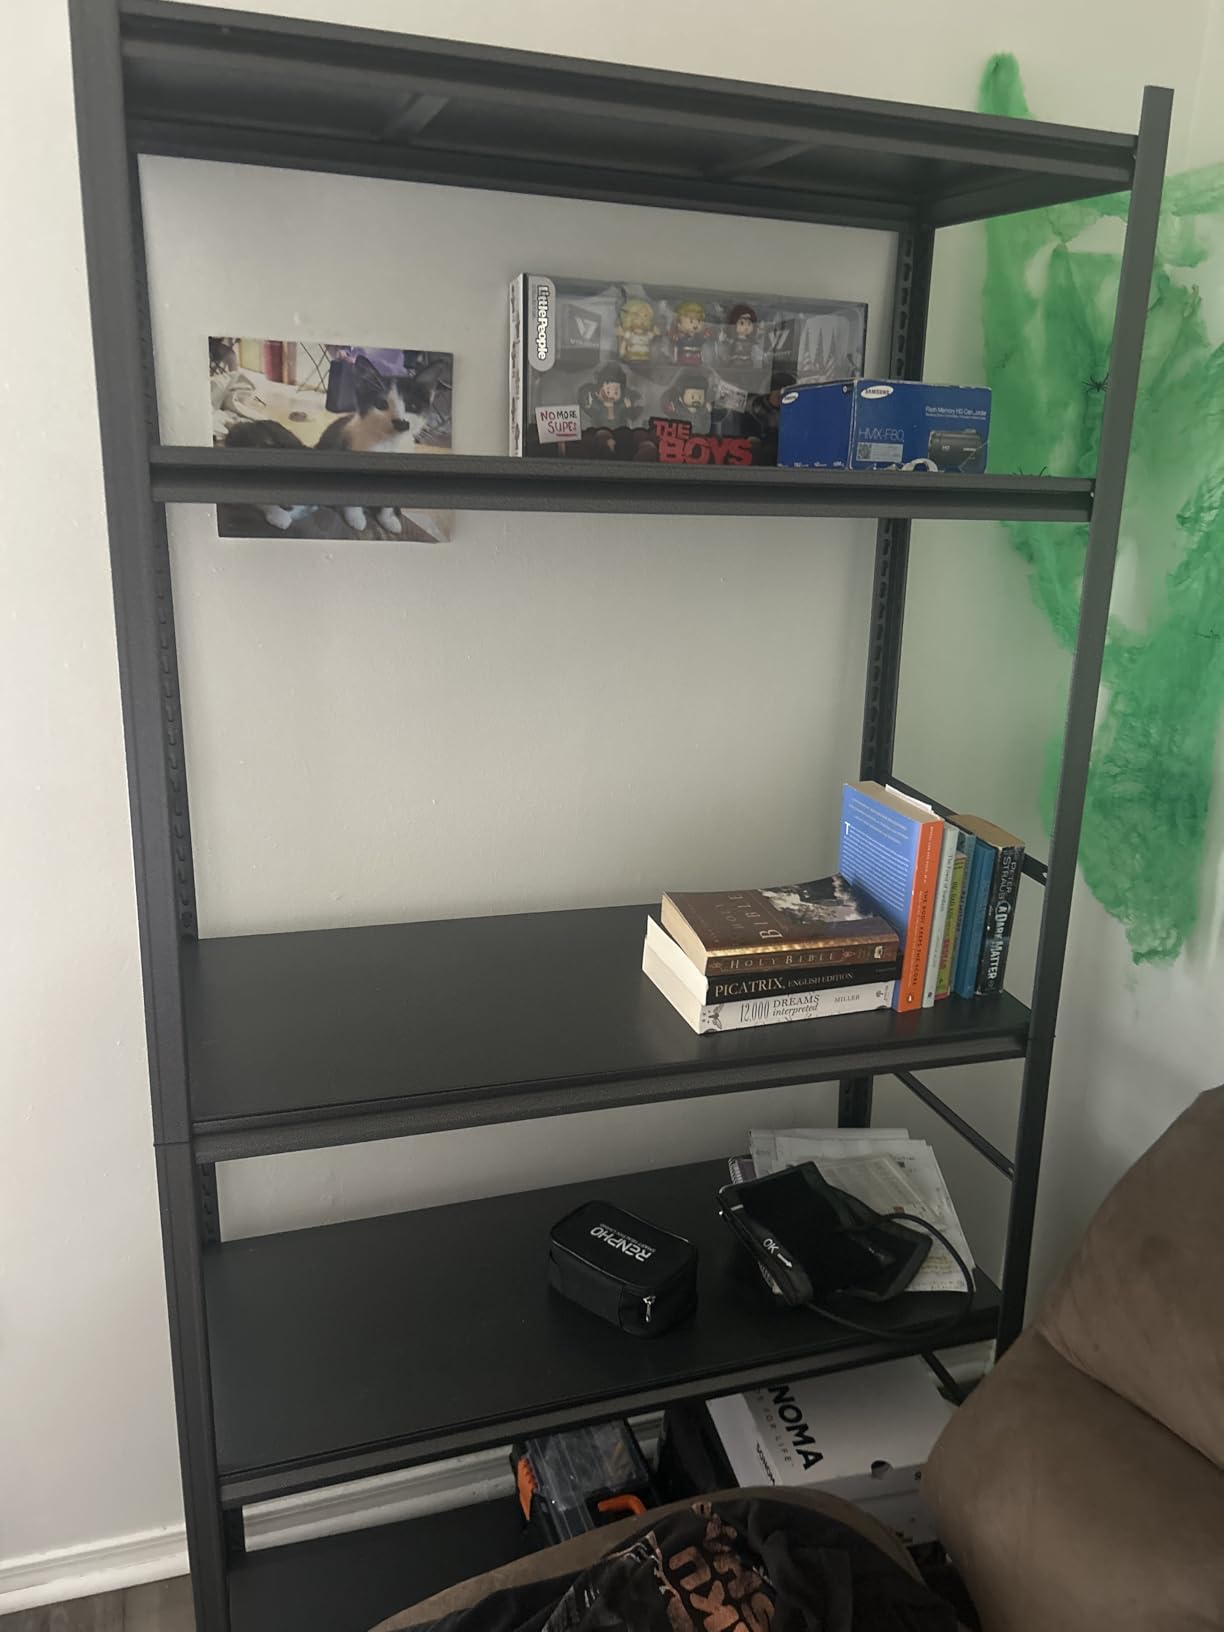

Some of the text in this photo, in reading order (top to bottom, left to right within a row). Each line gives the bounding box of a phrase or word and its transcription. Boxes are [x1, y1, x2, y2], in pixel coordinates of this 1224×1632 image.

[864, 388, 891, 396] SAMSUNG
[540, 409, 578, 421] NO MORE
[653, 418, 691, 440] THE
[658, 436, 753, 467] BOYS
[730, 949, 835, 969] HOLY BIBLE
[987, 940, 1004, 980] MATTER
[787, 976, 821, 989] ENGLISH
[821, 972, 853, 985] EDITION
[773, 994, 820, 1008] DREAMS
[834, 993, 860, 1004] MILLER
[772, 1003, 819, 1017] interpreted
[589, 1226, 653, 1262] RENPHO
[762, 1238, 780, 1255] OK
[767, 1385, 824, 1470] NOMA
